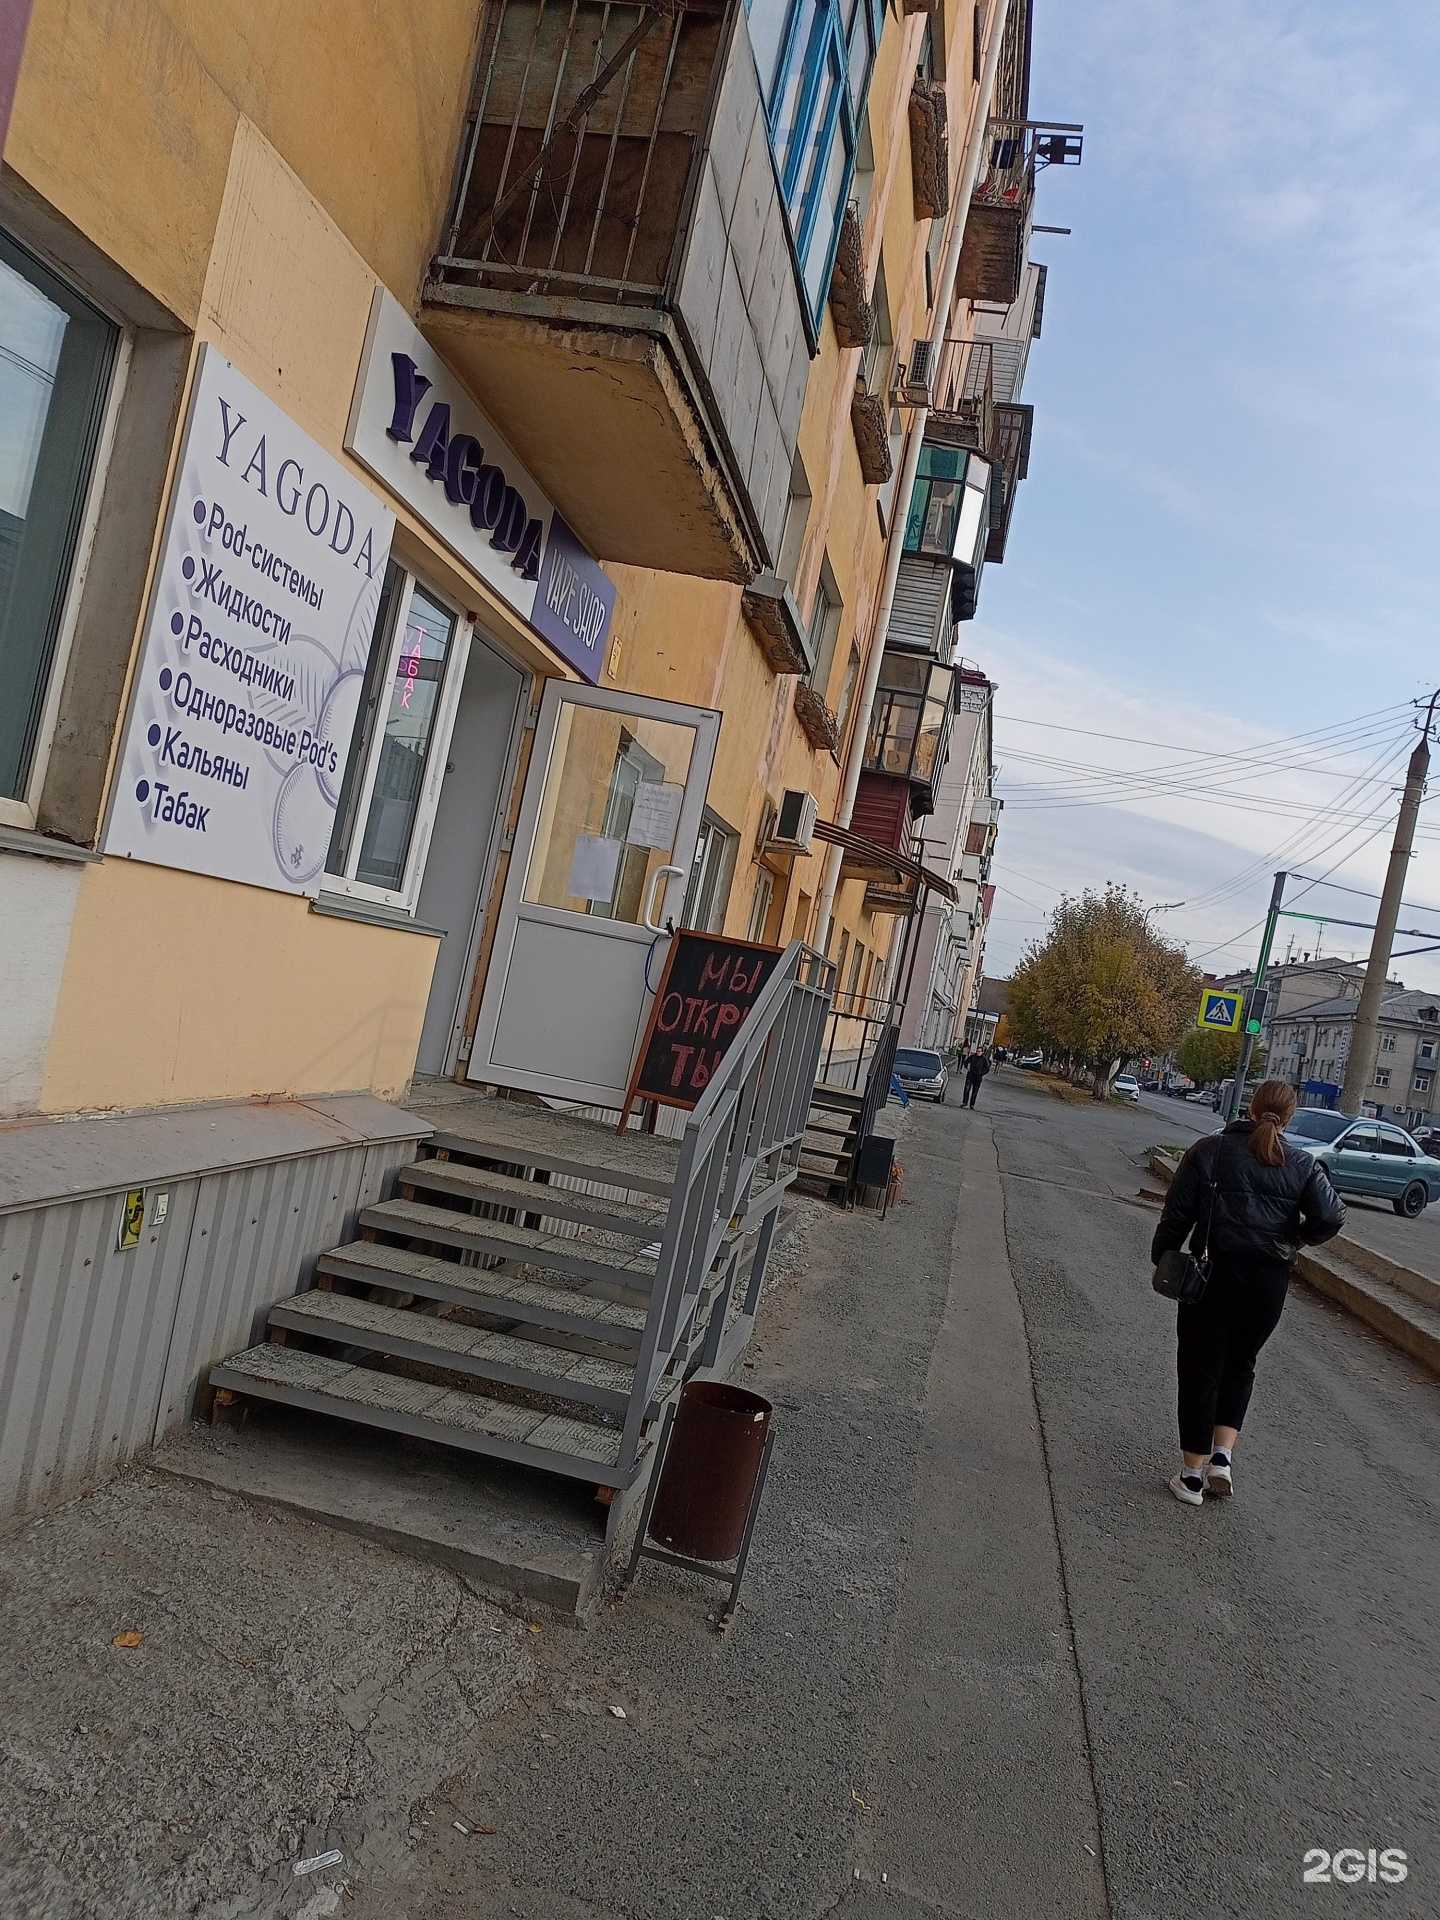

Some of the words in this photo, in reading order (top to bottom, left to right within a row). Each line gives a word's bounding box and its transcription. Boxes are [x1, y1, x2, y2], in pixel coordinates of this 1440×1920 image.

[216, 396, 373, 579] YAGODA
[386, 353, 543, 581] YAGODA
[207, 502, 324, 611] Pod-системы
[546, 548, 579, 626] VAPE
[573, 582, 606, 651] SHOP
[195, 557, 292, 646] Жидкости
[184, 614, 296, 702] Расходники
[401, 625, 428, 710] ТАБАК
[161, 726, 250, 790] Кальяны
[173, 672, 297, 755] Одноразовые
[299, 729, 338, 773] Pod's
[153, 782, 211, 832] Табак
[657, 992, 750, 1040] ОТКР
[698, 951, 764, 994] МЫ
